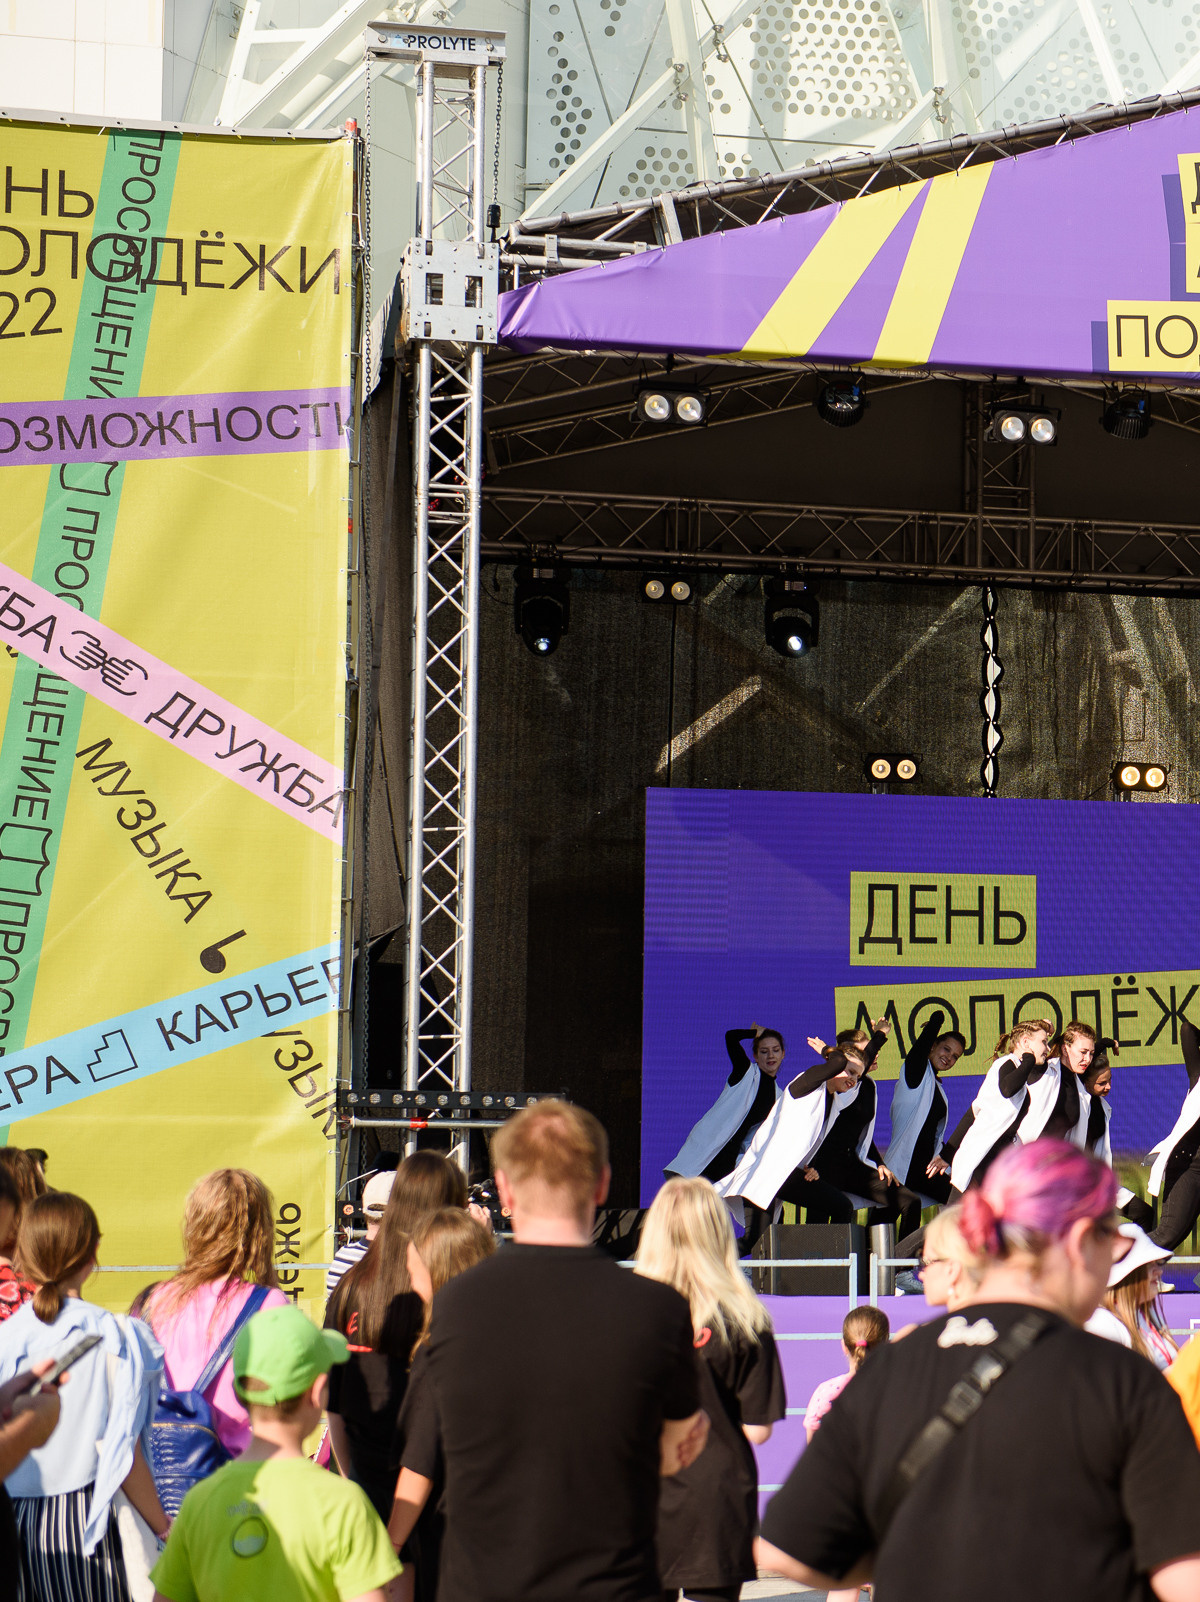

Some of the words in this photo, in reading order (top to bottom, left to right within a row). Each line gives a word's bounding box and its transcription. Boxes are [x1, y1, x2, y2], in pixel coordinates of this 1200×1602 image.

[407, 34, 476, 51] PROLYTE
[86, 131, 165, 400] ПРОСВЕЩЕНИ
[0, 586, 58, 654] БА
[144, 690, 344, 829] ДРУЖБА
[75, 736, 213, 925] МУЗЫКА
[857, 883, 1028, 956] ДЕНЬ
